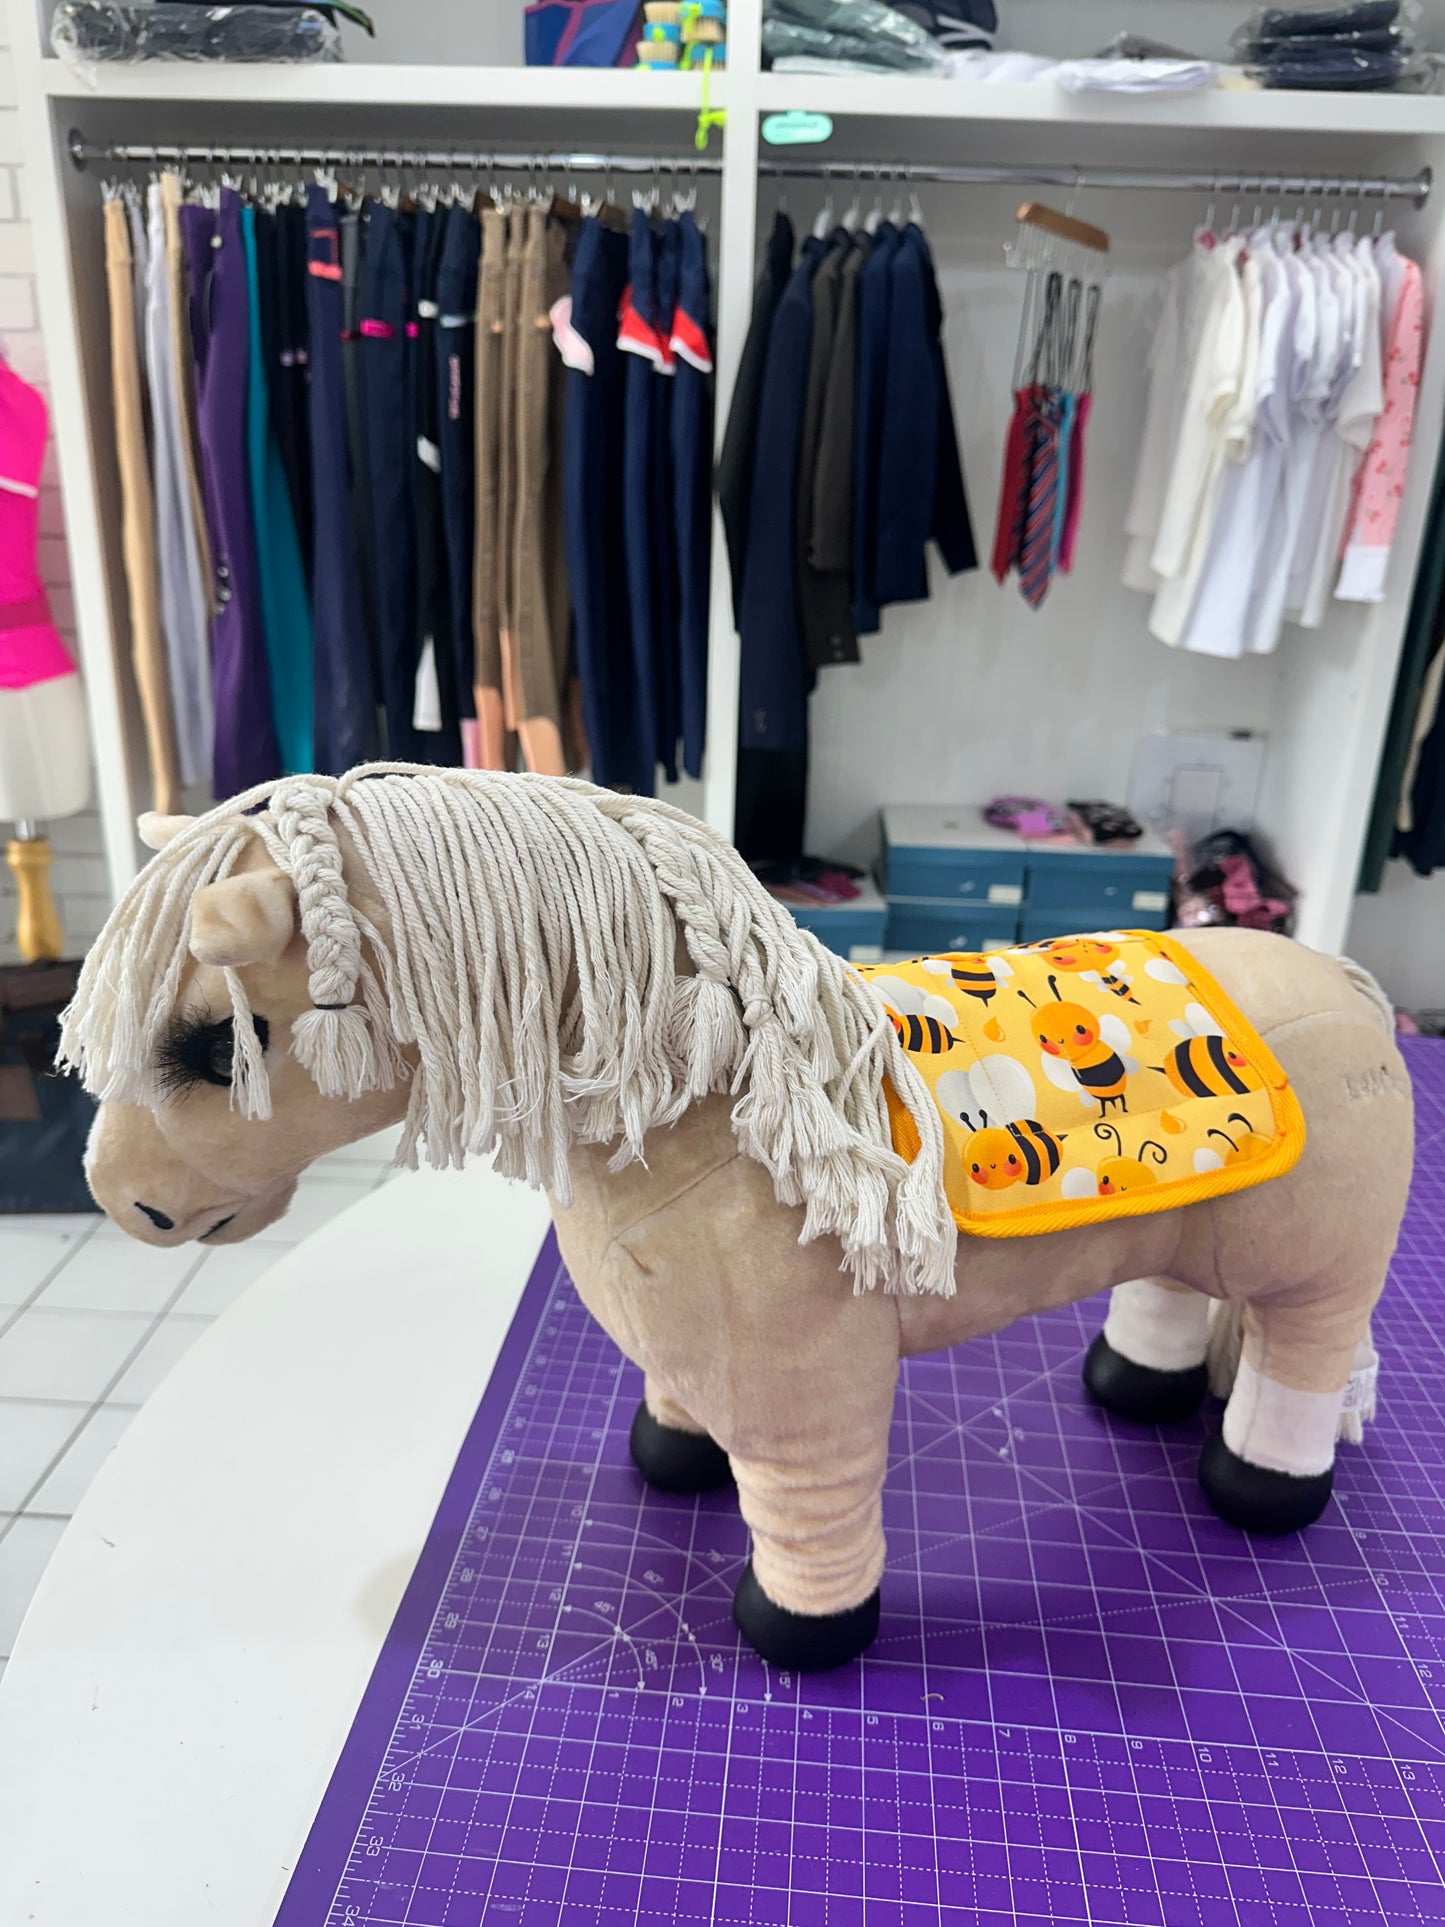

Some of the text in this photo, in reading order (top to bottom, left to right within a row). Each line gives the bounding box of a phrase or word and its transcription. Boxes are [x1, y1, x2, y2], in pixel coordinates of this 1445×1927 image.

[571, 1505, 583, 1517] 10
[562, 1545, 573, 1556] 11
[1375, 1573, 1389, 1585] 10
[549, 1588, 562, 1601] 12
[444, 1612, 459, 1628] 29
[1395, 1617, 1409, 1629] 11
[537, 1634, 550, 1648] 13
[427, 1660, 443, 1678] 30
[1418, 1664, 1432, 1678] 12
[524, 1684, 538, 1699] 14
[672, 1698, 684, 1707] 2
[737, 1704, 749, 1713] 3
[802, 1710, 813, 1719] 4
[867, 1716, 879, 1725] 5
[409, 1714, 425, 1730] 31
[932, 1721, 944, 1731] 6
[999, 1729, 1010, 1738] 7
[1065, 1734, 1077, 1744] 8
[1131, 1740, 1143, 1749] 9
[1198, 1746, 1212, 1763] 10
[1265, 1752, 1279, 1767] 11
[1333, 1758, 1347, 1774] 12
[1400, 1764, 1415, 1780] 13
[388, 1772, 405, 1791] 32
[366, 1836, 383, 1857] 33
[341, 1905, 360, 1927] 34
